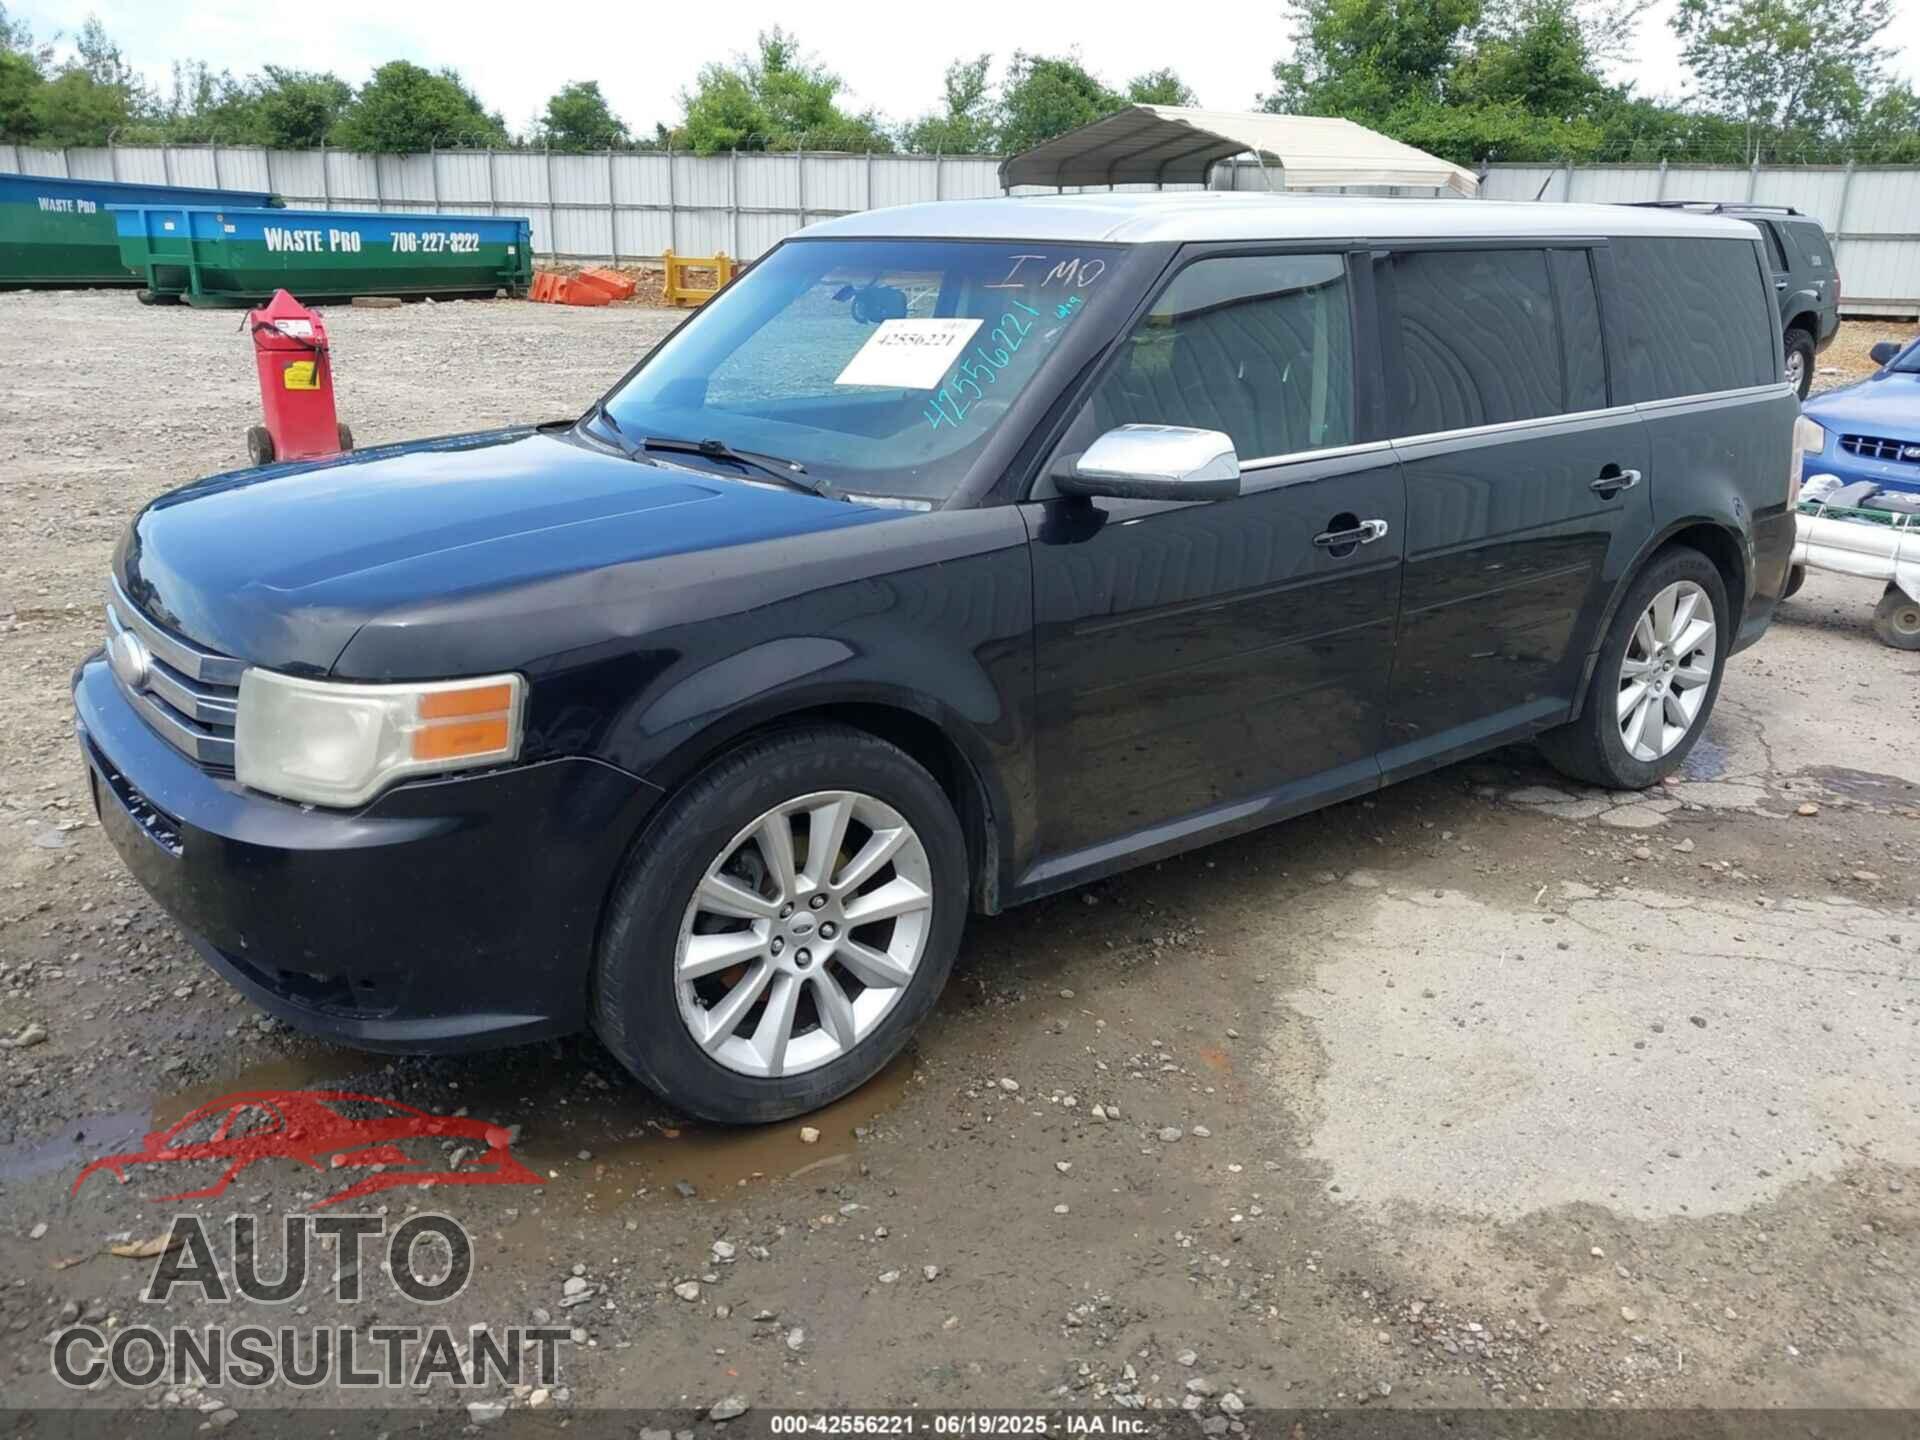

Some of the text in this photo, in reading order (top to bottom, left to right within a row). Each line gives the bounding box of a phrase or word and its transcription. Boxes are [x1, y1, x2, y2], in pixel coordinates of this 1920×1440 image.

[38, 197, 96, 214] WASTE PRO
[264, 227, 361, 252] WASTE PRO
[390, 232, 480, 252] 706-227-3222
[924, 300, 1040, 430] 42556221
